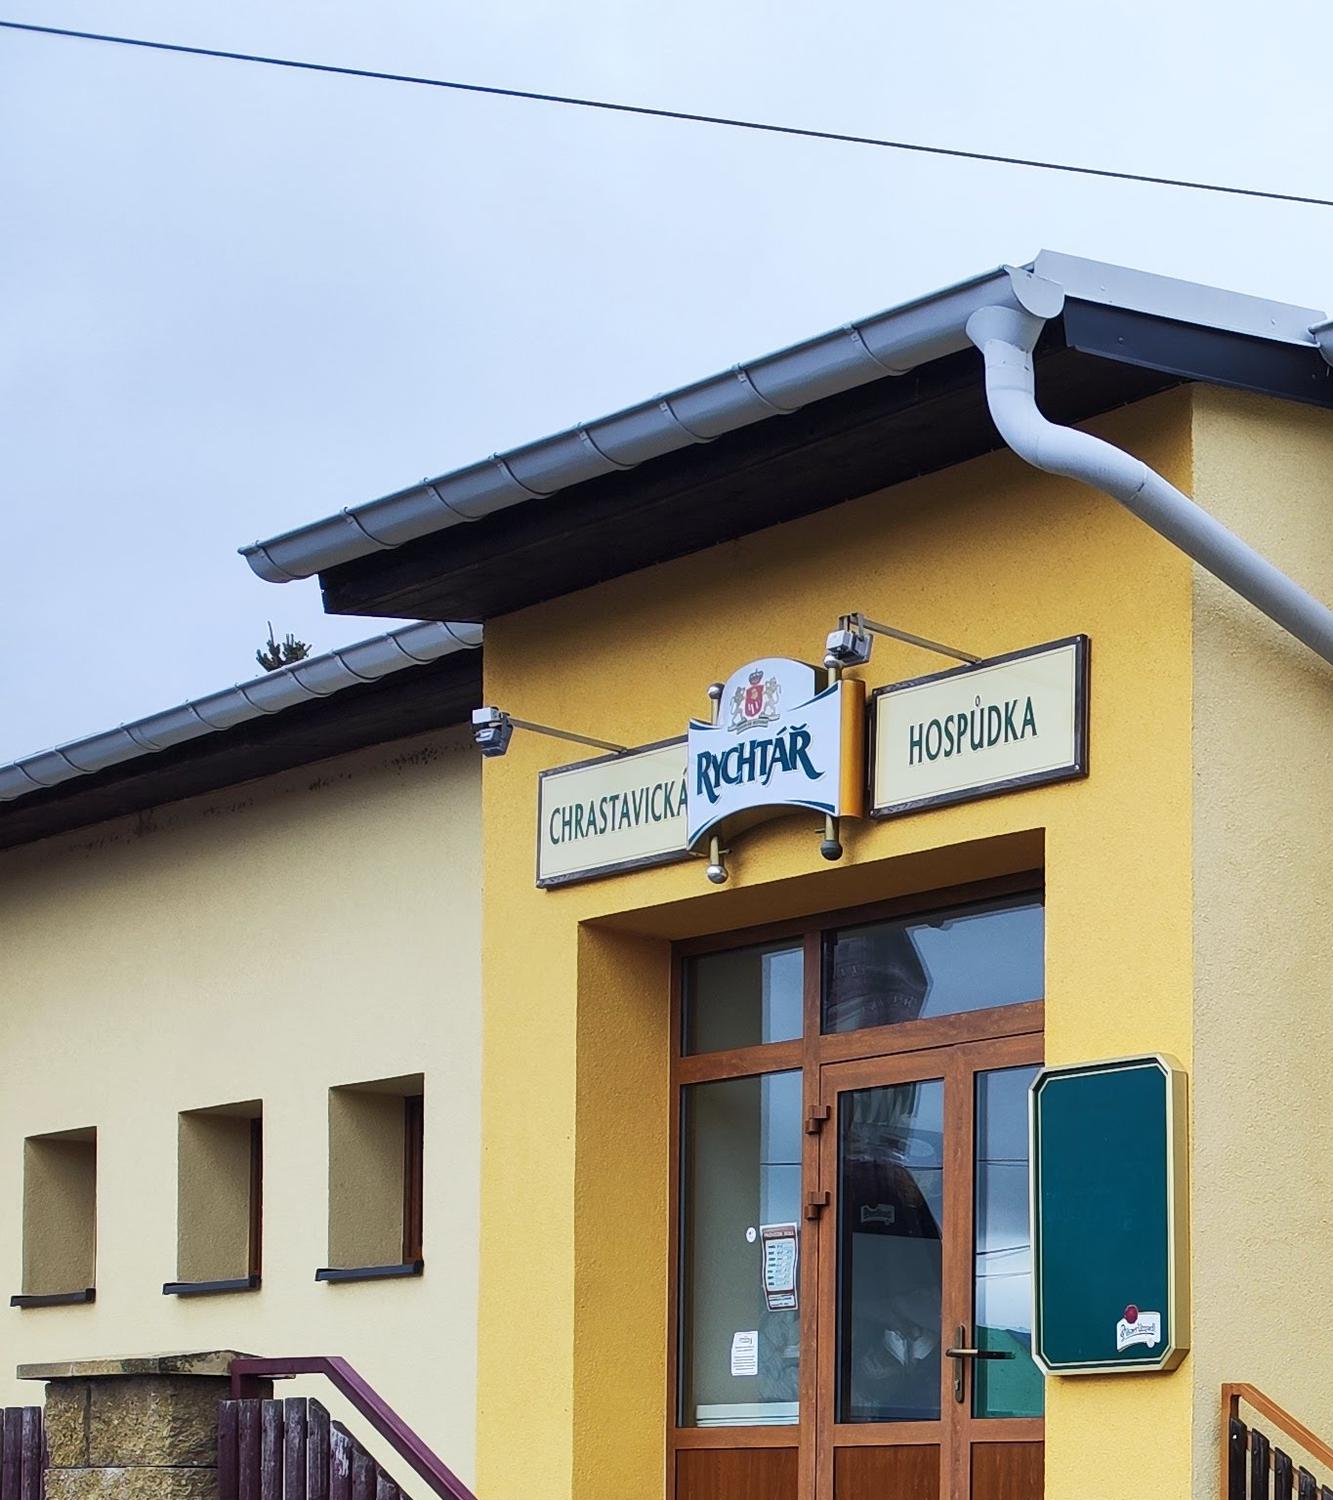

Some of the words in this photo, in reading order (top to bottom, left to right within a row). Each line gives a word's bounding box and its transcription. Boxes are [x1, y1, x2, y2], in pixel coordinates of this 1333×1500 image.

[696, 722, 825, 804] RYCHTÁŘ
[909, 695, 1037, 765] HOSPŮDKA
[550, 767, 688, 844] CHRASTAVICKÁ
